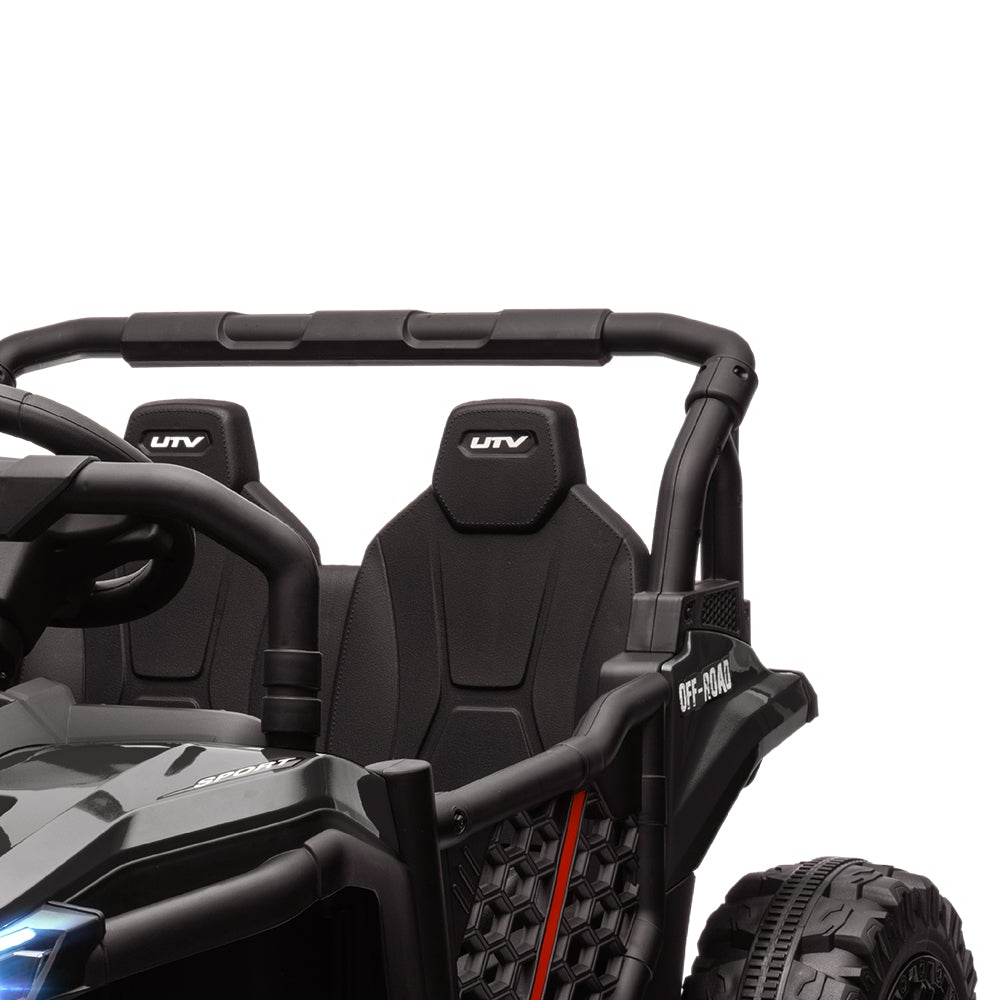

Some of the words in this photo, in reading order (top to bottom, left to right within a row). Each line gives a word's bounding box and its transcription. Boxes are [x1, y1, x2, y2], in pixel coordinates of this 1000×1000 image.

[150, 435, 206, 449] UTV
[469, 435, 530, 450] UTV
[678, 658, 732, 713] OFF-ROAD
[193, 757, 297, 788] SPORT
